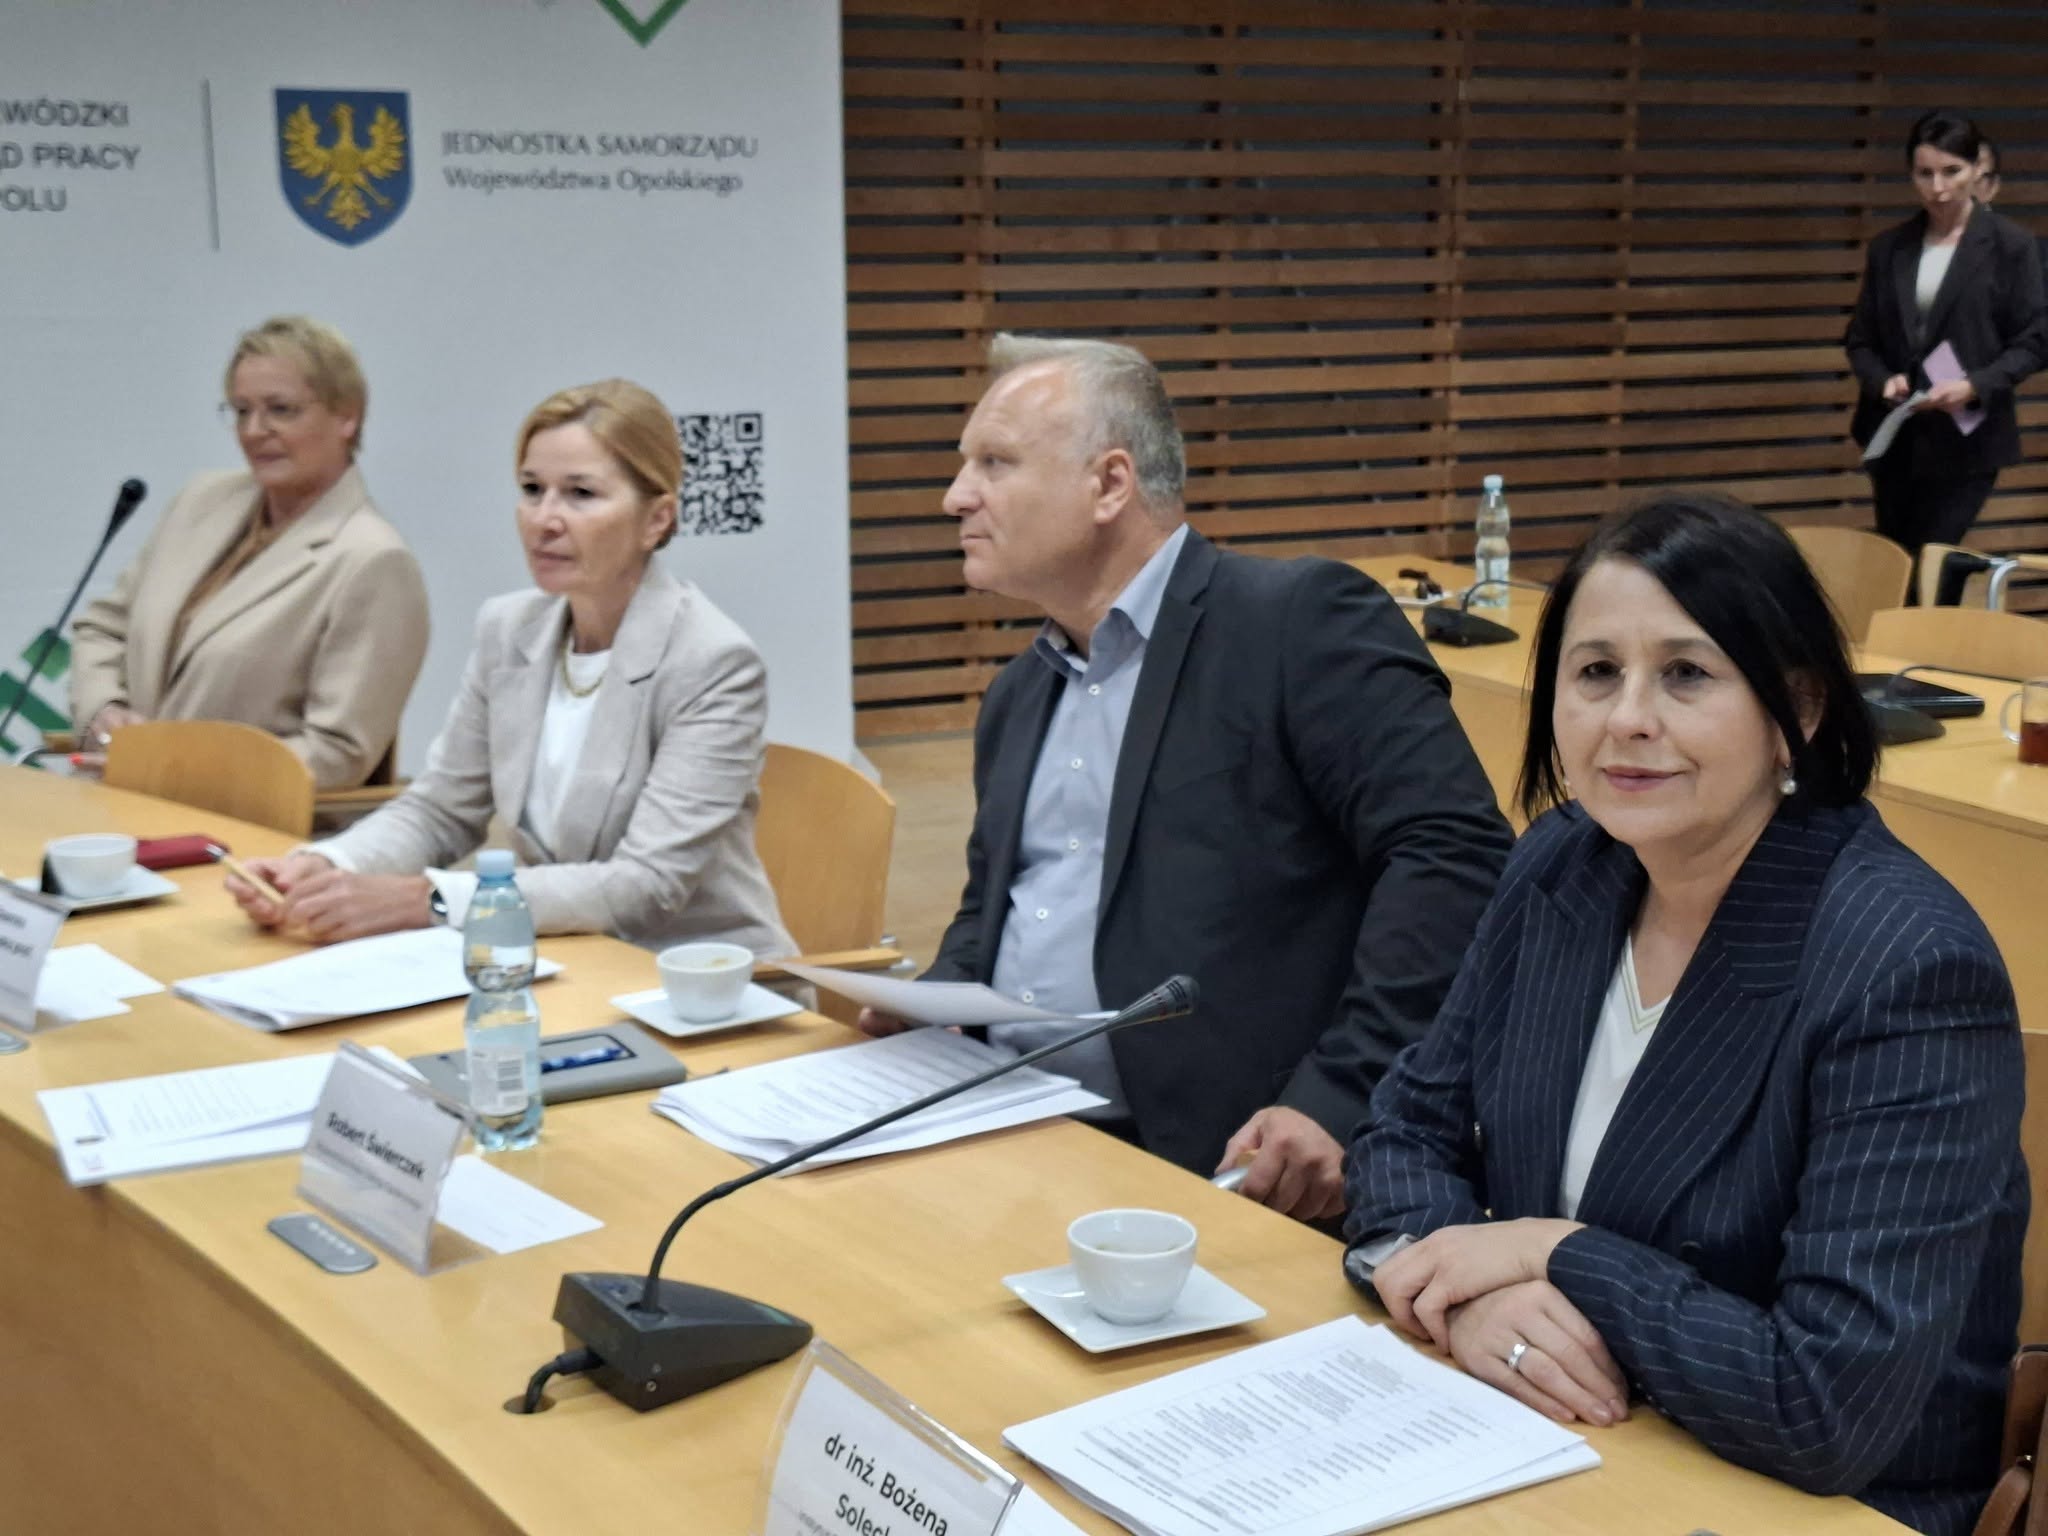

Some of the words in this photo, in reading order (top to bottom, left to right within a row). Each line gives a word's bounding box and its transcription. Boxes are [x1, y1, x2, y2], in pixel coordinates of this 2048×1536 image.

[0, 96, 129, 127] WÓDZKI
[0, 142, 24, 171] D
[32, 143, 141, 170] PRACY
[442, 131, 592, 156] JEDNOSTKA
[596, 132, 759, 161] SAMORZĄDU
[442, 167, 610, 195] Województwa
[616, 168, 743, 197] Opolskiego
[0, 185, 68, 212] OLU
[824, 1433, 846, 1462] dr
[846, 1444, 875, 1488] inż.
[880, 1472, 948, 1536] Bożena
